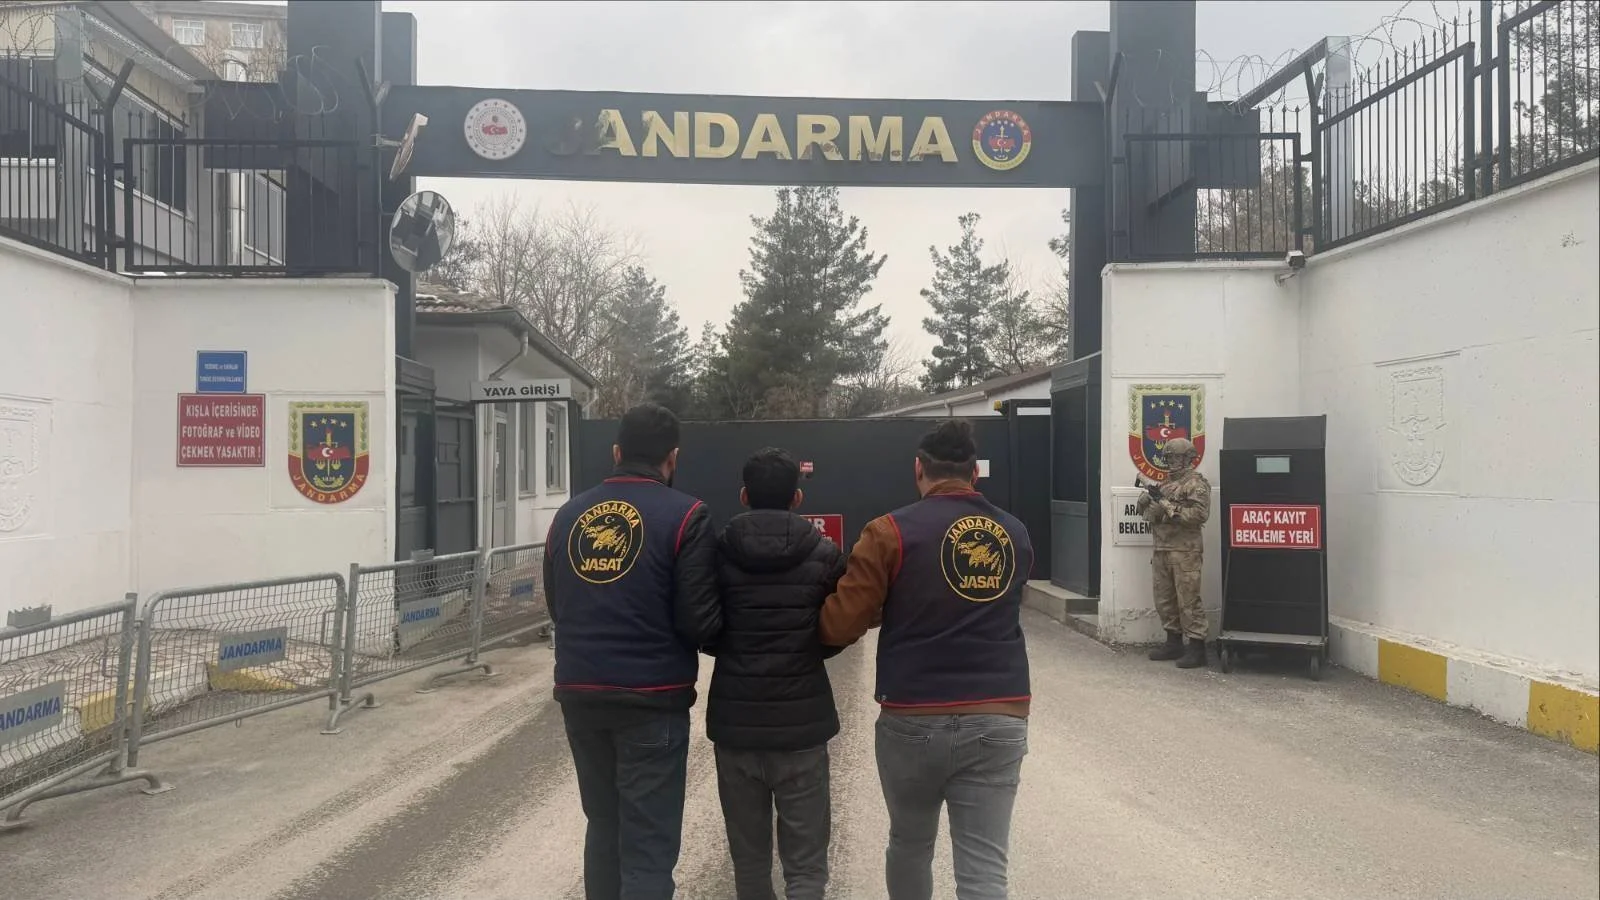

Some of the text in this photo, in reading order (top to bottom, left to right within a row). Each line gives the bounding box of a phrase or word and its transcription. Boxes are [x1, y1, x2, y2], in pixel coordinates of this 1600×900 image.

[483, 384, 560, 396] YAYA GİRİŞİ
[186, 401, 257, 418] KIŞLA İÇERİSİNDE
[182, 423, 260, 438] FOTOĞRAF ve VİDEO
[181, 446, 215, 459] ÇEKMEK
[217, 447, 256, 458] YASAKTIR
[293, 474, 365, 501] JANDARMA
[580, 503, 640, 529] JANDARMA
[1125, 504, 1144, 517] ARA
[1242, 511, 1306, 527] ARAÇ KAYIT
[948, 519, 1009, 547] JANDARMA
[1119, 522, 1152, 534] BEKLEM
[1235, 527, 1314, 544] BEKLEME YERİ
[581, 558, 624, 571] JASAT
[960, 575, 1001, 589] JASAT
[401, 607, 440, 623] JANDARMA
[220, 637, 283, 660] JANDARMA
